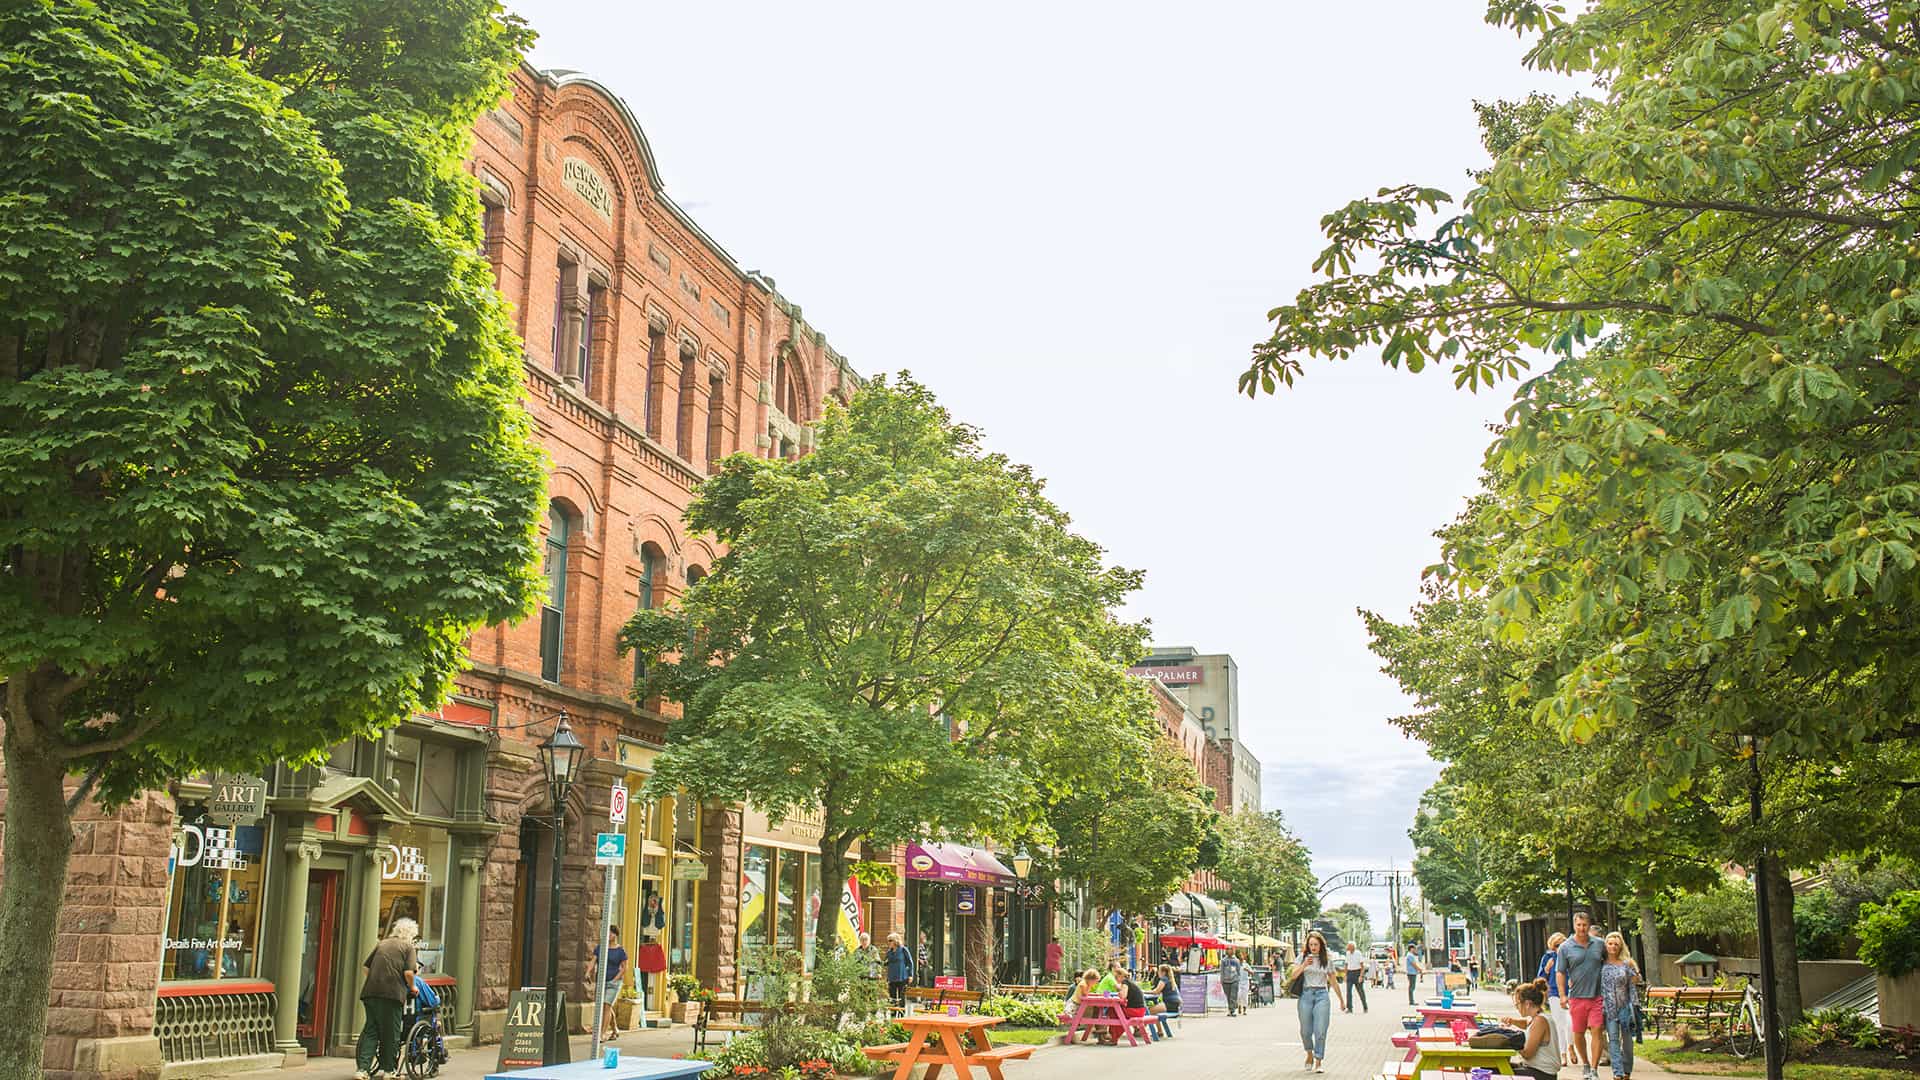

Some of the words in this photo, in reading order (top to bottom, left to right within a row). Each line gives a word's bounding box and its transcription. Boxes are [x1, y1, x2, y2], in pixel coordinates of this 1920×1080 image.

[564, 162, 611, 217] NEWSON
[1157, 671, 1199, 681] PALMER
[215, 785, 260, 803] ART
[214, 804, 257, 813] GALLERY
[840, 891, 861, 938] OPE
[164, 938, 190, 949] Details
[190, 938, 206, 949] Fine
[206, 938, 219, 950] Art
[220, 938, 243, 951] Gallery
[507, 1001, 547, 1026] AR
[513, 1047, 540, 1055] Pottery
